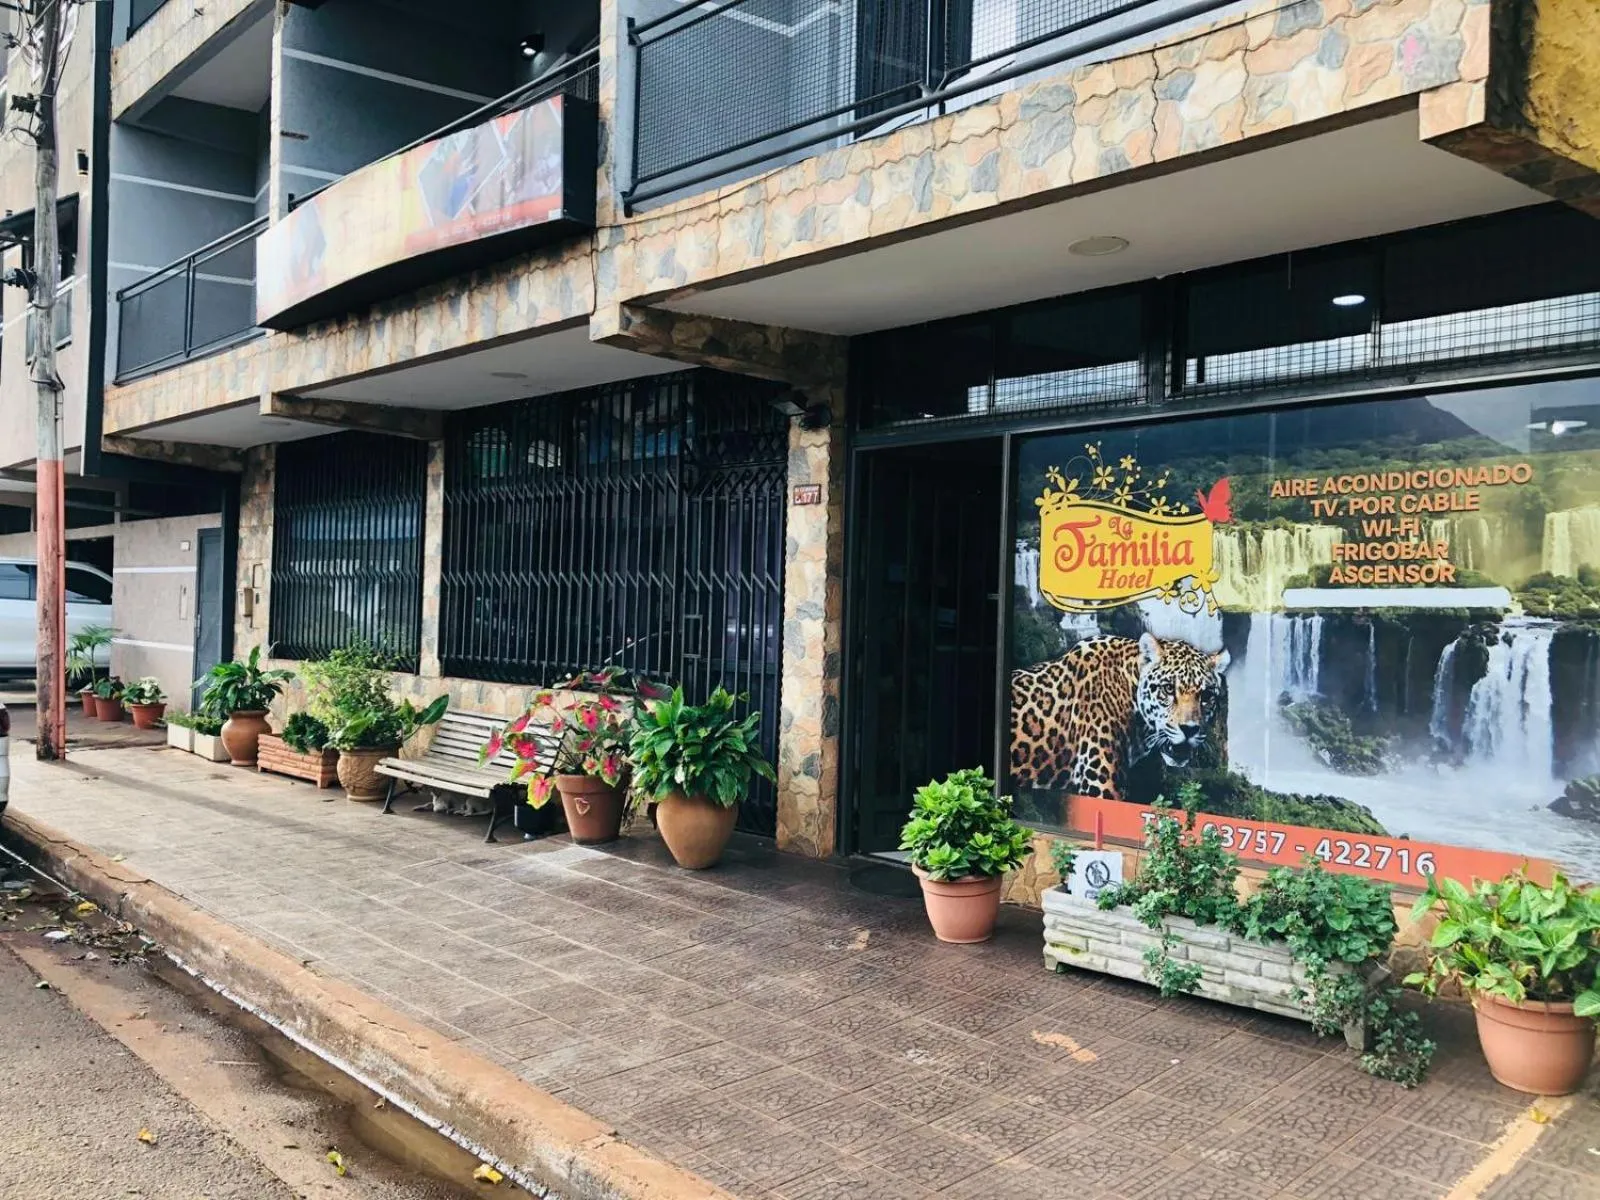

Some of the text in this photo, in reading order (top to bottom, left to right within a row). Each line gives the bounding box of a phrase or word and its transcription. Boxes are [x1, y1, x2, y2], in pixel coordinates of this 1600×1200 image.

[1270, 463, 1533, 498] AIRE ACONDICIONADO
[1311, 490, 1480, 518] TV. POR CABLE
[1108, 516, 1134, 541] La
[1362, 516, 1420, 538] WI-FI
[1053, 515, 1195, 573] Familia
[1331, 540, 1449, 562] FRIGOBAR
[1097, 568, 1154, 589] Hotel
[1329, 563, 1457, 585] ASCENSOR
[1314, 837, 1436, 877] 422716
